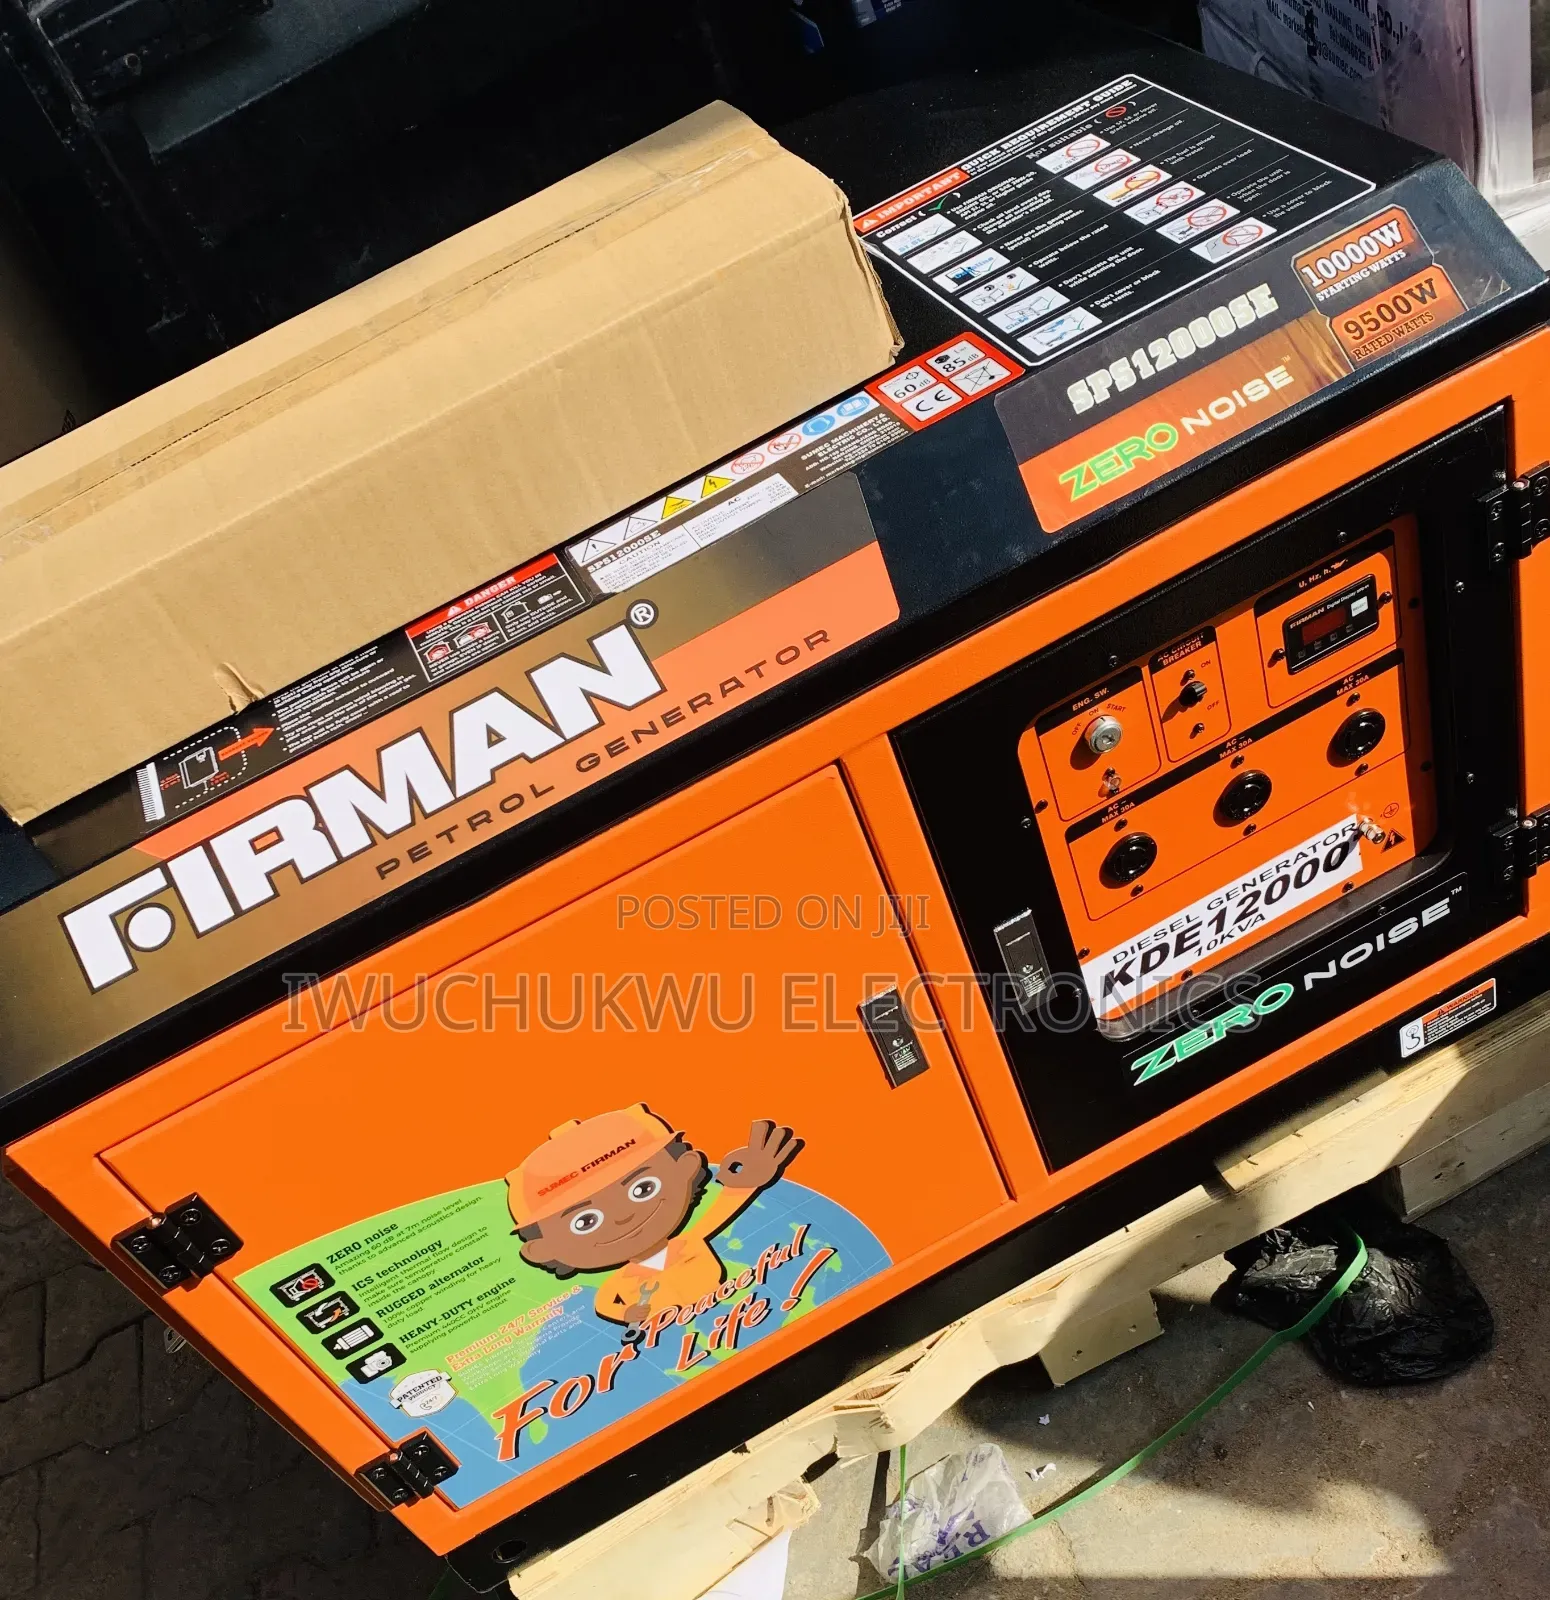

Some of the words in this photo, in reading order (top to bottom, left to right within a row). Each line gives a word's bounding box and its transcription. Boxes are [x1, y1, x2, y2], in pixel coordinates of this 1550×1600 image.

[875, 171, 963, 218] IMPORTANT
[959, 147, 1002, 170] QUICK
[999, 100, 1094, 149] REQUIREMENT
[1090, 79, 1135, 102] GUIDE
[1024, 146, 1048, 159] Not
[1045, 122, 1094, 148] suitable
[874, 214, 918, 238] Correct
[1301, 217, 1403, 288] 10000W
[1316, 268, 1372, 302] STARTING
[1368, 249, 1407, 282] WATTS
[1343, 277, 1440, 341] 9500W
[1067, 283, 1280, 415] SPS12000SE
[1352, 332, 1393, 362] RATED
[1390, 311, 1435, 346] WATTS
[942, 357, 967, 373] 85
[968, 353, 979, 362] dB
[893, 383, 917, 399] 60
[919, 378, 931, 388] dB
[801, 443, 830, 461] SUMEC
[818, 435, 855, 457] ELECTRIC
[872, 417, 891, 427] LTD.
[1058, 421, 1180, 503] ZERO
[726, 496, 741, 506] AC
[586, 529, 661, 573] SPS12000SE
[617, 540, 661, 565] CAUTION
[464, 575, 516, 606] DANGER
[1290, 607, 1325, 629] FIRMAN
[1326, 599, 1340, 610] Digital
[1340, 591, 1356, 602] Display
[1162, 640, 1202, 666] BREAKER
[1200, 659, 1211, 669] ON
[1072, 696, 1093, 712] ENG.
[1094, 687, 1110, 700] SW.
[1336, 683, 1353, 695] MAX
[1355, 675, 1369, 685] 30A
[1342, 675, 1353, 684] AC
[1089, 707, 1099, 717] ON
[1106, 703, 1126, 713] START
[1206, 700, 1220, 711] OFF
[1071, 722, 1082, 736] OFF
[1219, 744, 1238, 759] MAX
[1238, 736, 1252, 748] 30A
[1224, 738, 1237, 748] AC
[374, 781, 556, 882] PETROL
[574, 628, 833, 774] GENERATOR
[57, 618, 667, 994] FIRMAN
[1101, 809, 1119, 823] MAX
[1119, 800, 1135, 813] 30A
[1106, 802, 1119, 813] AC
[1112, 914, 1202, 965] DIESEL
[1206, 820, 1359, 912] GENERATOR
[1102, 839, 1352, 999] KDE12000
[1194, 913, 1268, 958] 10KVA
[1446, 988, 1480, 1010] WARNING
[1130, 982, 1295, 1087] ZERO
[537, 1170, 579, 1197] SUMEC
[580, 1138, 636, 1172] FIRMAN
[325, 1240, 362, 1265] ZERO
[363, 1220, 399, 1245] noise
[334, 1248, 370, 1271] Amazing
[370, 1241, 381, 1251] 60
[382, 1234, 394, 1244] dB
[395, 1229, 404, 1237] at
[420, 1209, 442, 1224] noise
[442, 1198, 462, 1211] level
[338, 1257, 367, 1276] thanks
[366, 1252, 376, 1260] to
[376, 1230, 416, 1255] advanced
[416, 1210, 454, 1234] acoustics
[351, 1274, 375, 1292] ICS
[375, 1238, 443, 1281] technology
[358, 1273, 399, 1299] Intelligent
[399, 1255, 431, 1276] thermal
[432, 1245, 449, 1258] flow
[449, 1230, 477, 1250] design
[478, 1225, 487, 1233] to
[362, 1287, 386, 1303] make
[386, 1278, 404, 1290] sure
[404, 1250, 454, 1281] temperature
[454, 1231, 489, 1253] constant
[367, 1291, 391, 1308] inside
[391, 1283, 406, 1294] the
[375, 1285, 426, 1319] RUGGED
[427, 1253, 485, 1291] alternator
[383, 1309, 404, 1324] 100%
[405, 1293, 433, 1313] copper
[433, 1275, 465, 1297] winding
[466, 1268, 478, 1279] for
[478, 1255, 502, 1272] heavy
[638, 1223, 811, 1350] Peaceful
[386, 1315, 406, 1330] duty
[398, 1297, 473, 1345] HEAVY-DUTY
[475, 1274, 516, 1303] engine
[404, 1326, 440, 1349] Premium
[466, 1302, 485, 1315] OHV
[485, 1288, 512, 1306] engine
[409, 1331, 446, 1354] supplying
[447, 1312, 481, 1334] powerful
[481, 1297, 508, 1315] output
[445, 1330, 497, 1364] Premium
[497, 1313, 526, 1335] 24/7
[527, 1289, 571, 1319] Service
[451, 1350, 482, 1373] Extra
[481, 1333, 512, 1357] Long
[512, 1303, 565, 1340] Warranty
[397, 1375, 443, 1403] PATENTED
[492, 1340, 639, 1463] For
